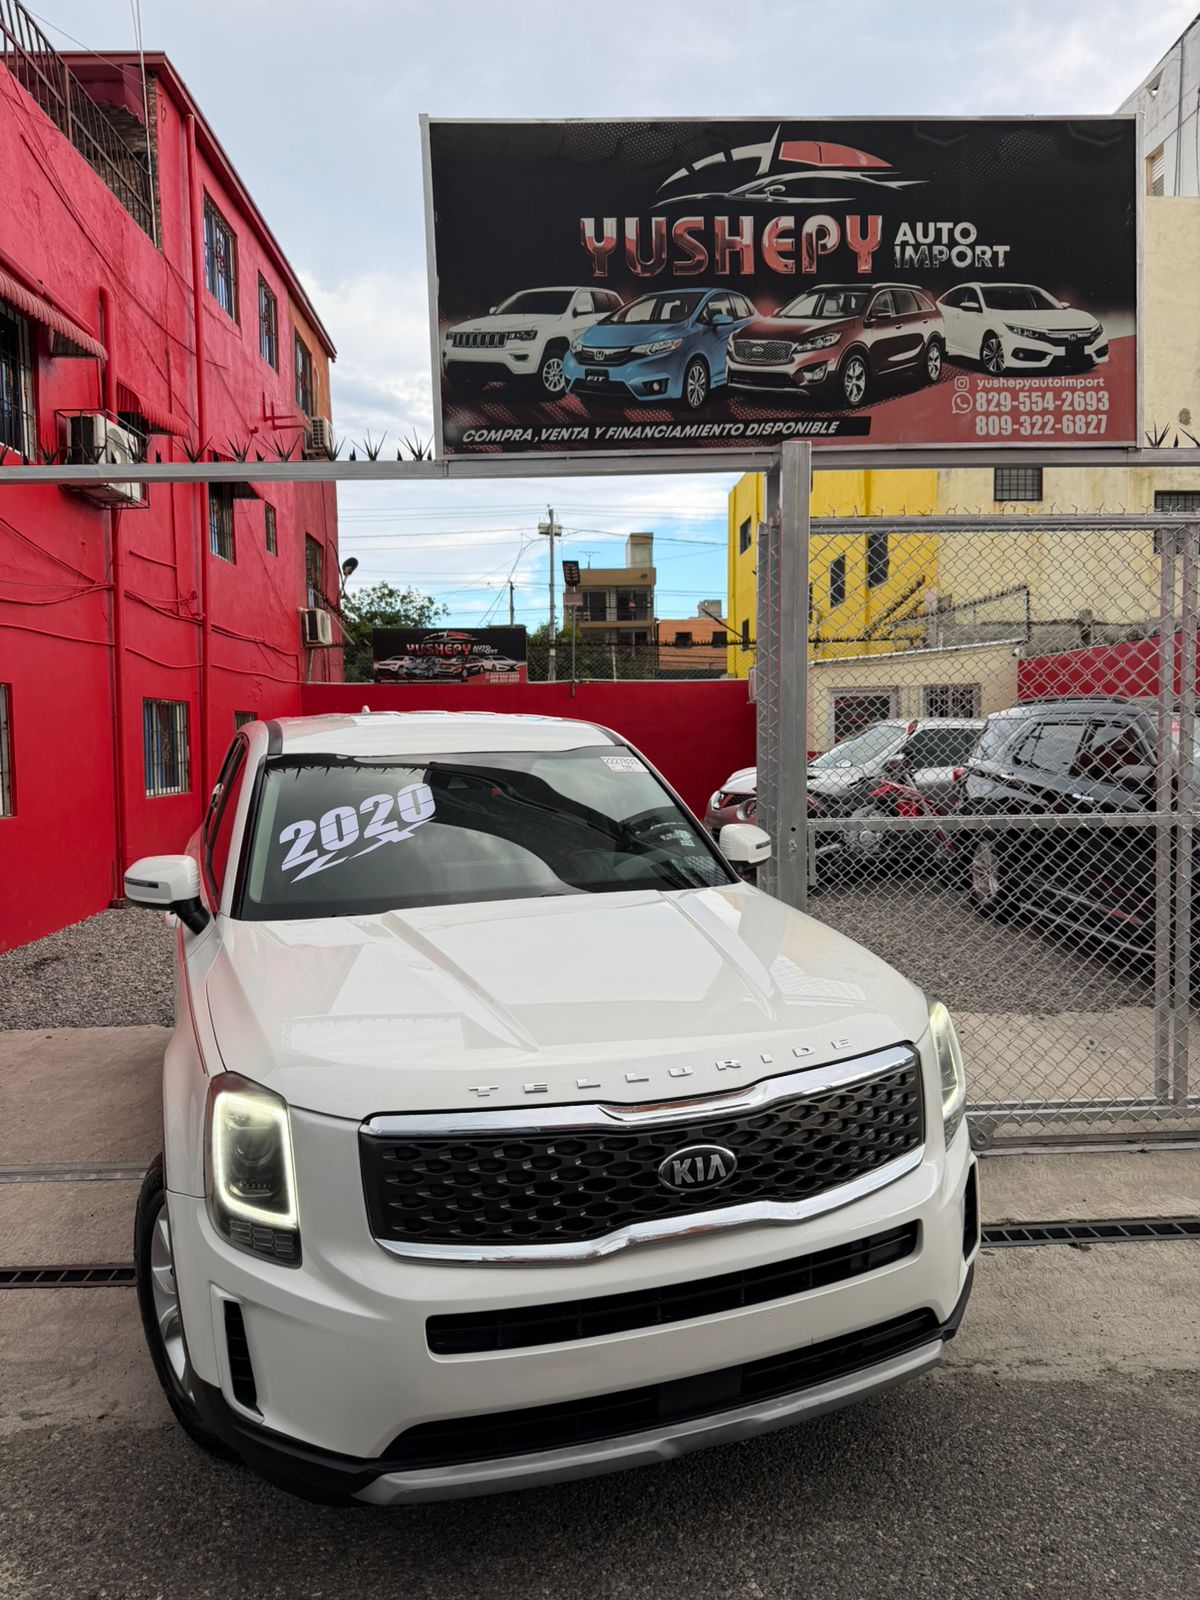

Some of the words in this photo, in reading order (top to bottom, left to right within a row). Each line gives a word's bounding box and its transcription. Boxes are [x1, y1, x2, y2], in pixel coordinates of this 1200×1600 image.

[579, 214, 883, 278] YUSHEPY
[894, 221, 978, 246] AUTO
[894, 244, 1011, 269] IMPORT
[976, 376, 1105, 391] yushepyautoimport
[975, 390, 1110, 413] 829-554-2693
[593, 426, 606, 440] Y
[605, 423, 744, 440] FINANCIAMIENTO
[745, 421, 840, 436] DISPONIBLE
[975, 414, 1108, 436] 809-322-6827
[279, 781, 437, 873] 2020
[468, 1037, 853, 1098] TELLURIDE
[671, 1153, 727, 1186] KIA
